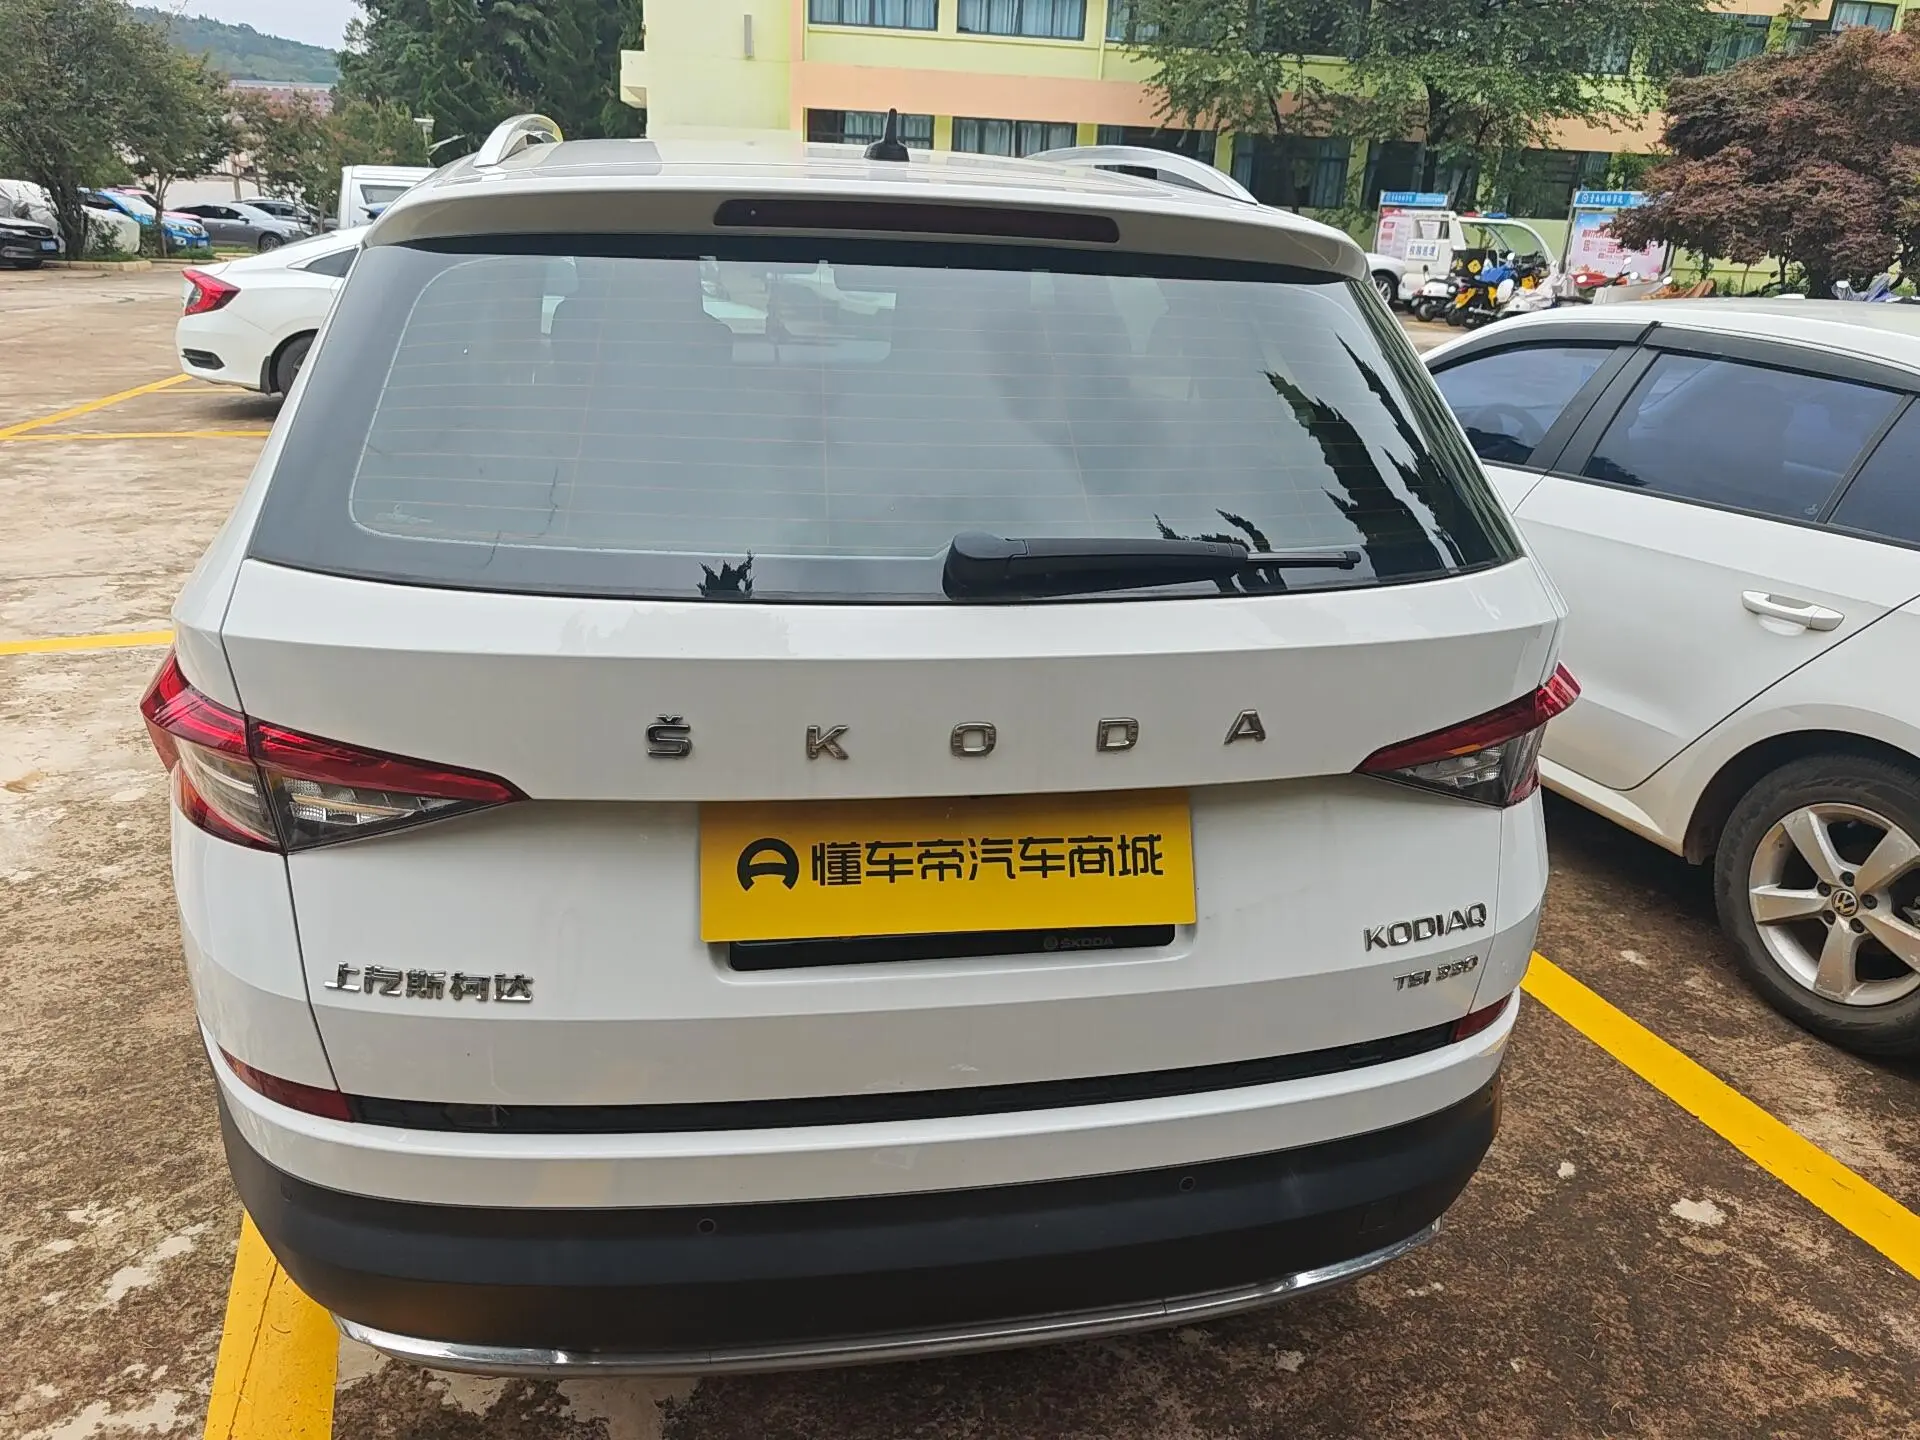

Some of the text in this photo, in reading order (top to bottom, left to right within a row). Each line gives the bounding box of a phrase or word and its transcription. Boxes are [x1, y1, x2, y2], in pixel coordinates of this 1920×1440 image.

[812, 834, 1163, 886] 懂车帝汽车商城
[1363, 902, 1487, 951] KODIAQ
[324, 961, 535, 1003] 上汽斯柯达
[1393, 969, 1432, 991] TSI
